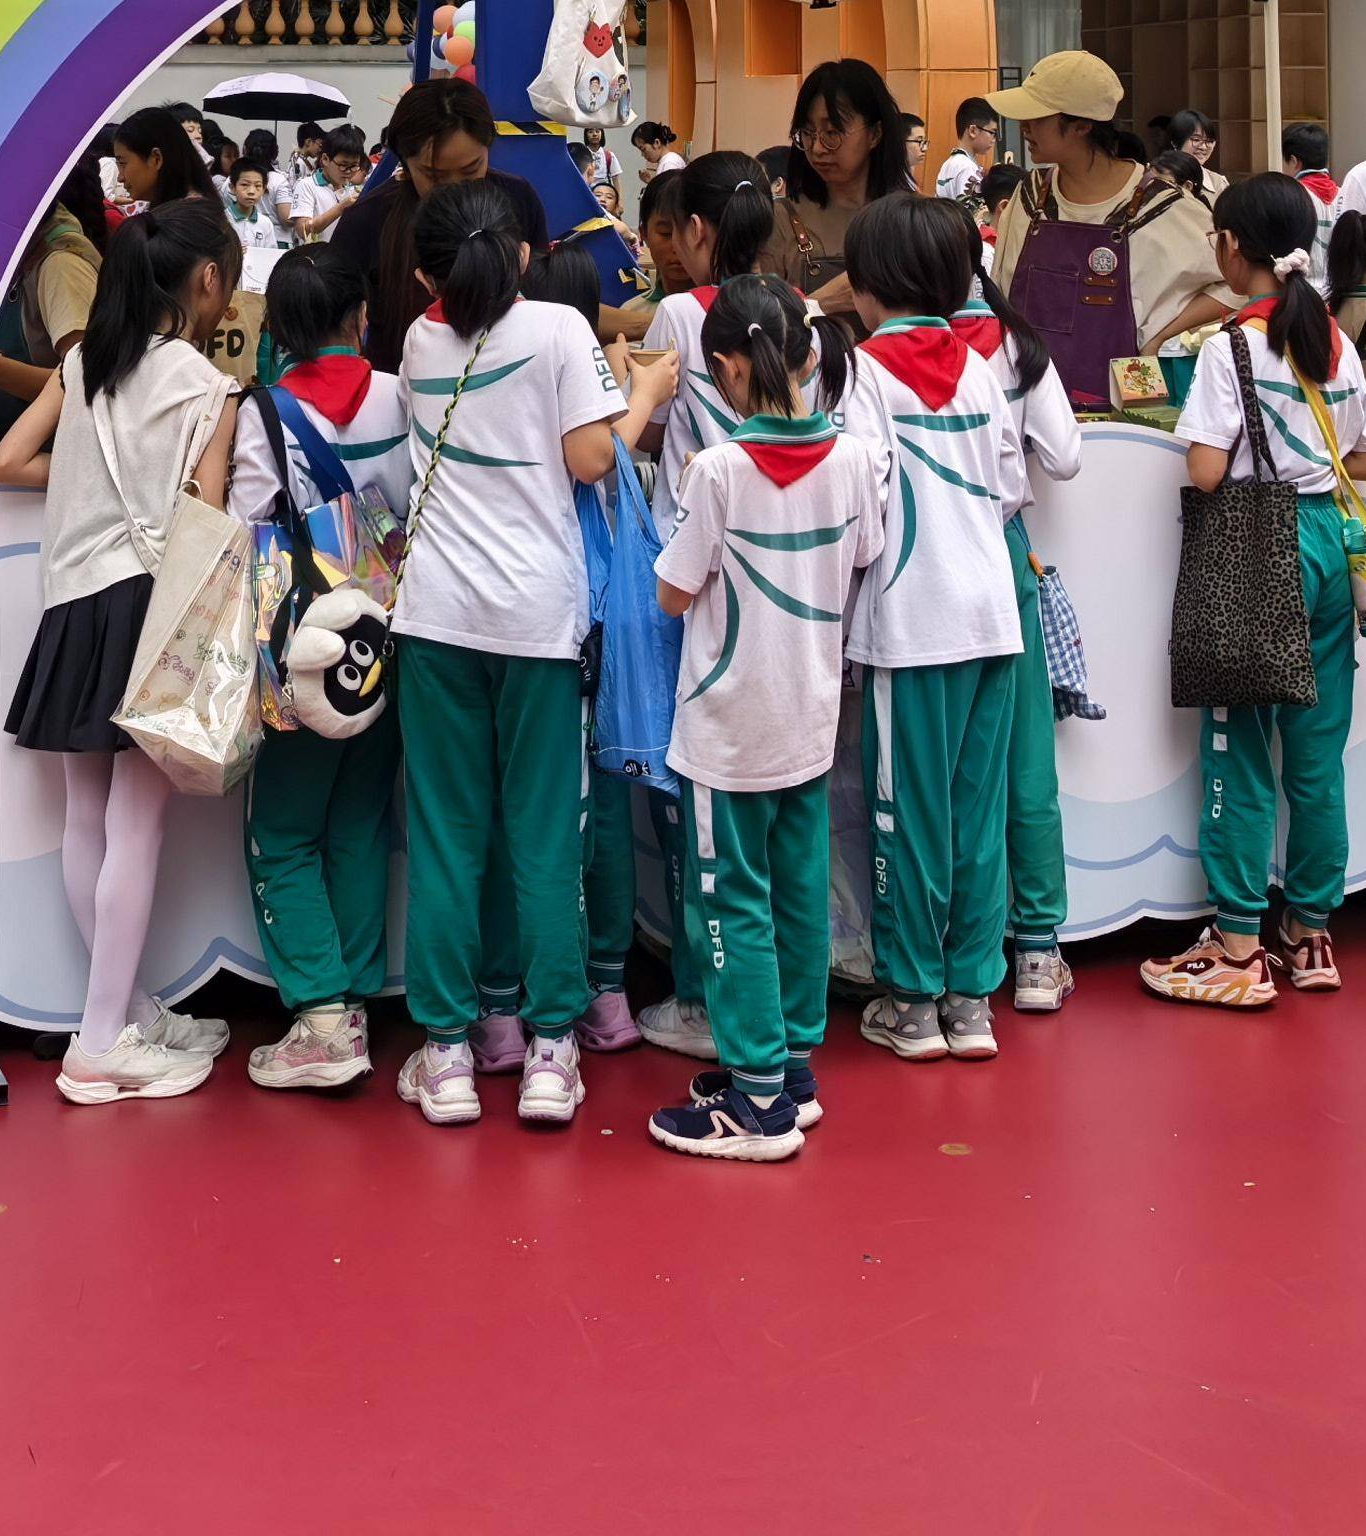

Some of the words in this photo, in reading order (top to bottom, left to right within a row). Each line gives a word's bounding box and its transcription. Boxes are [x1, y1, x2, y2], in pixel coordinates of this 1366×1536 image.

[1211, 778, 1224, 819] DFD
[875, 856, 887, 894] DFD
[707, 918, 725, 970] DFD
[1186, 962, 1206, 971] FILA
